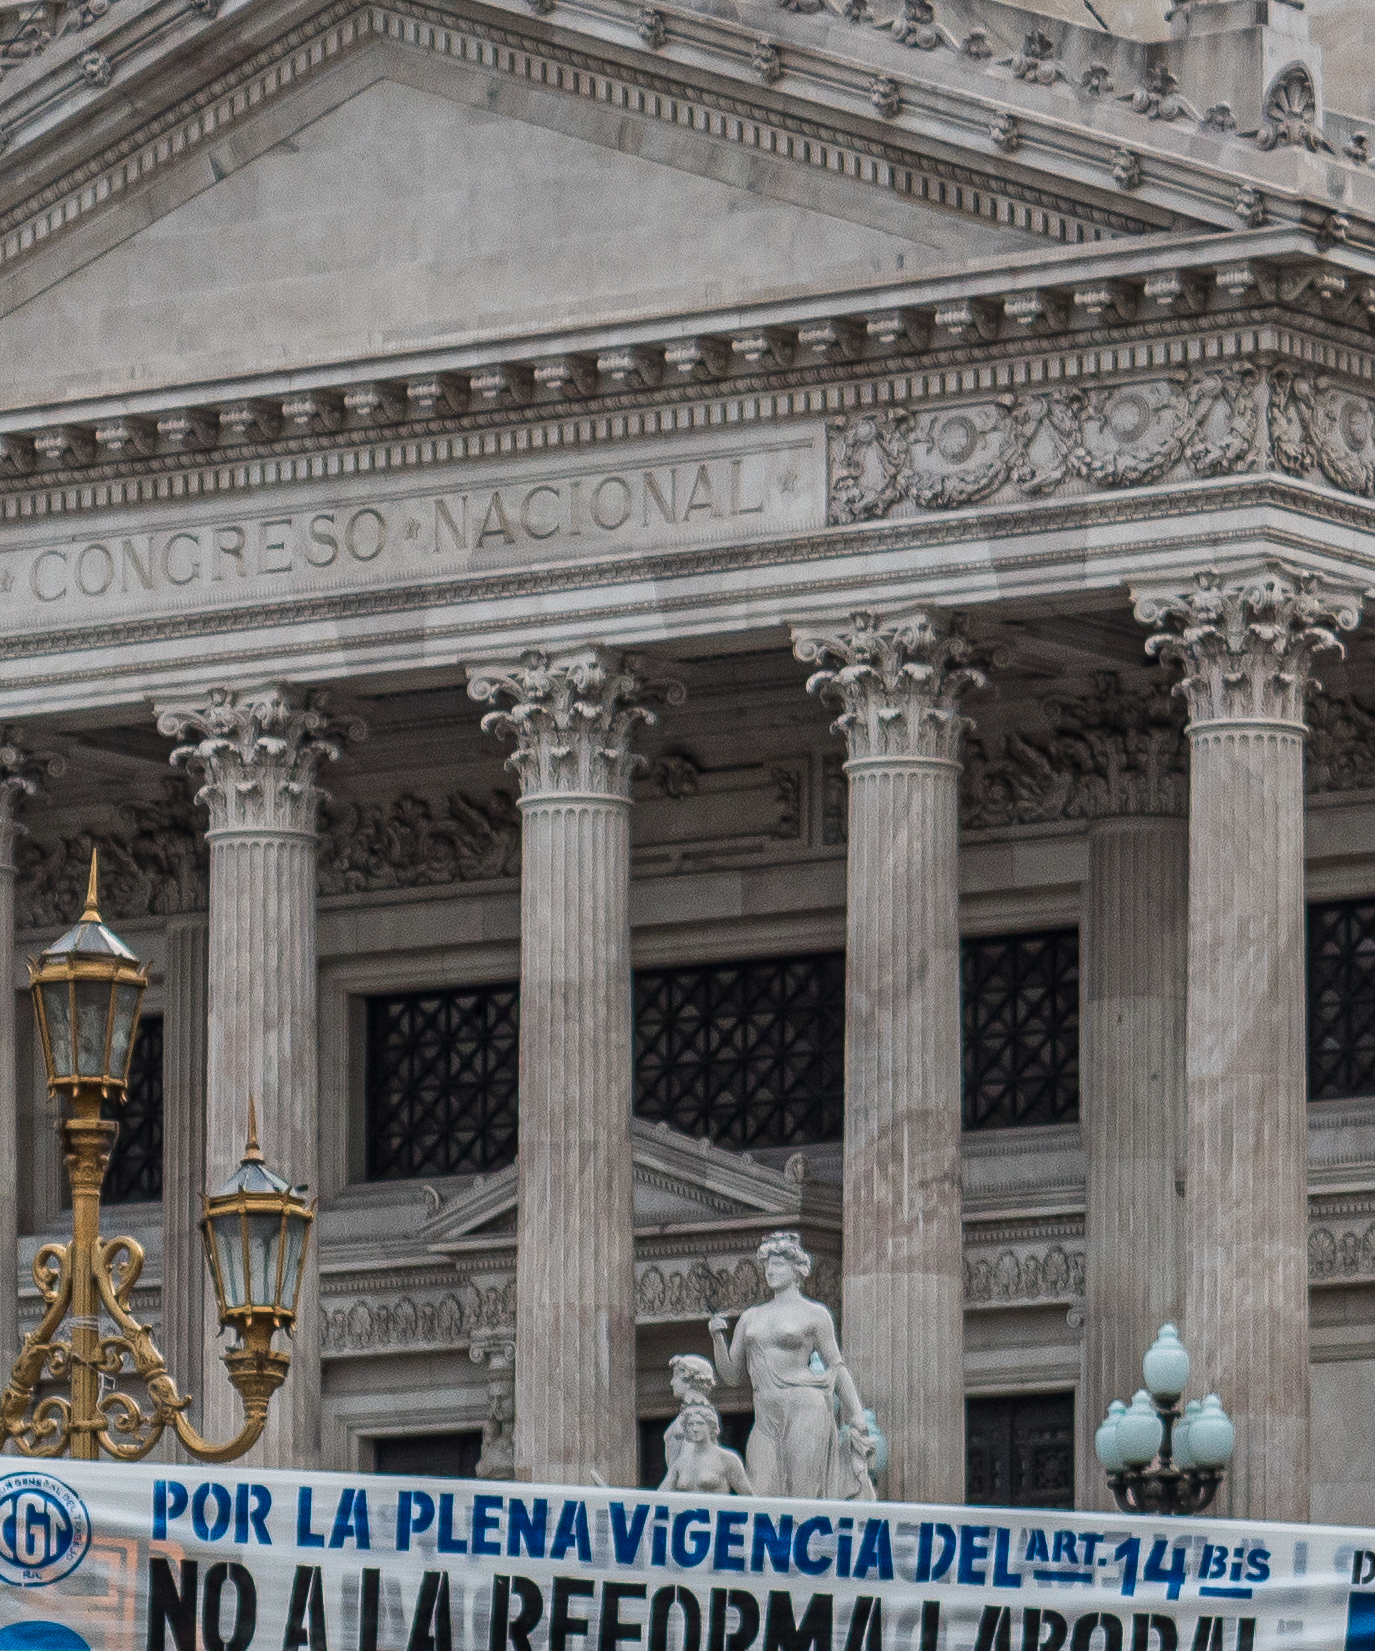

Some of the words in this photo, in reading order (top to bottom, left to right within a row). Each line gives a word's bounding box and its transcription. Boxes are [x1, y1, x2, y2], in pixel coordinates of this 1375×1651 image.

[28, 506, 387, 602] CONGRESO
[432, 457, 763, 555] NACIONAL
[152, 1479, 272, 1545] POR
[296, 1485, 371, 1550] LA
[396, 1490, 592, 1562] PLENA
[915, 1521, 1023, 1588] DEL
[1114, 1535, 1187, 1602] 14
